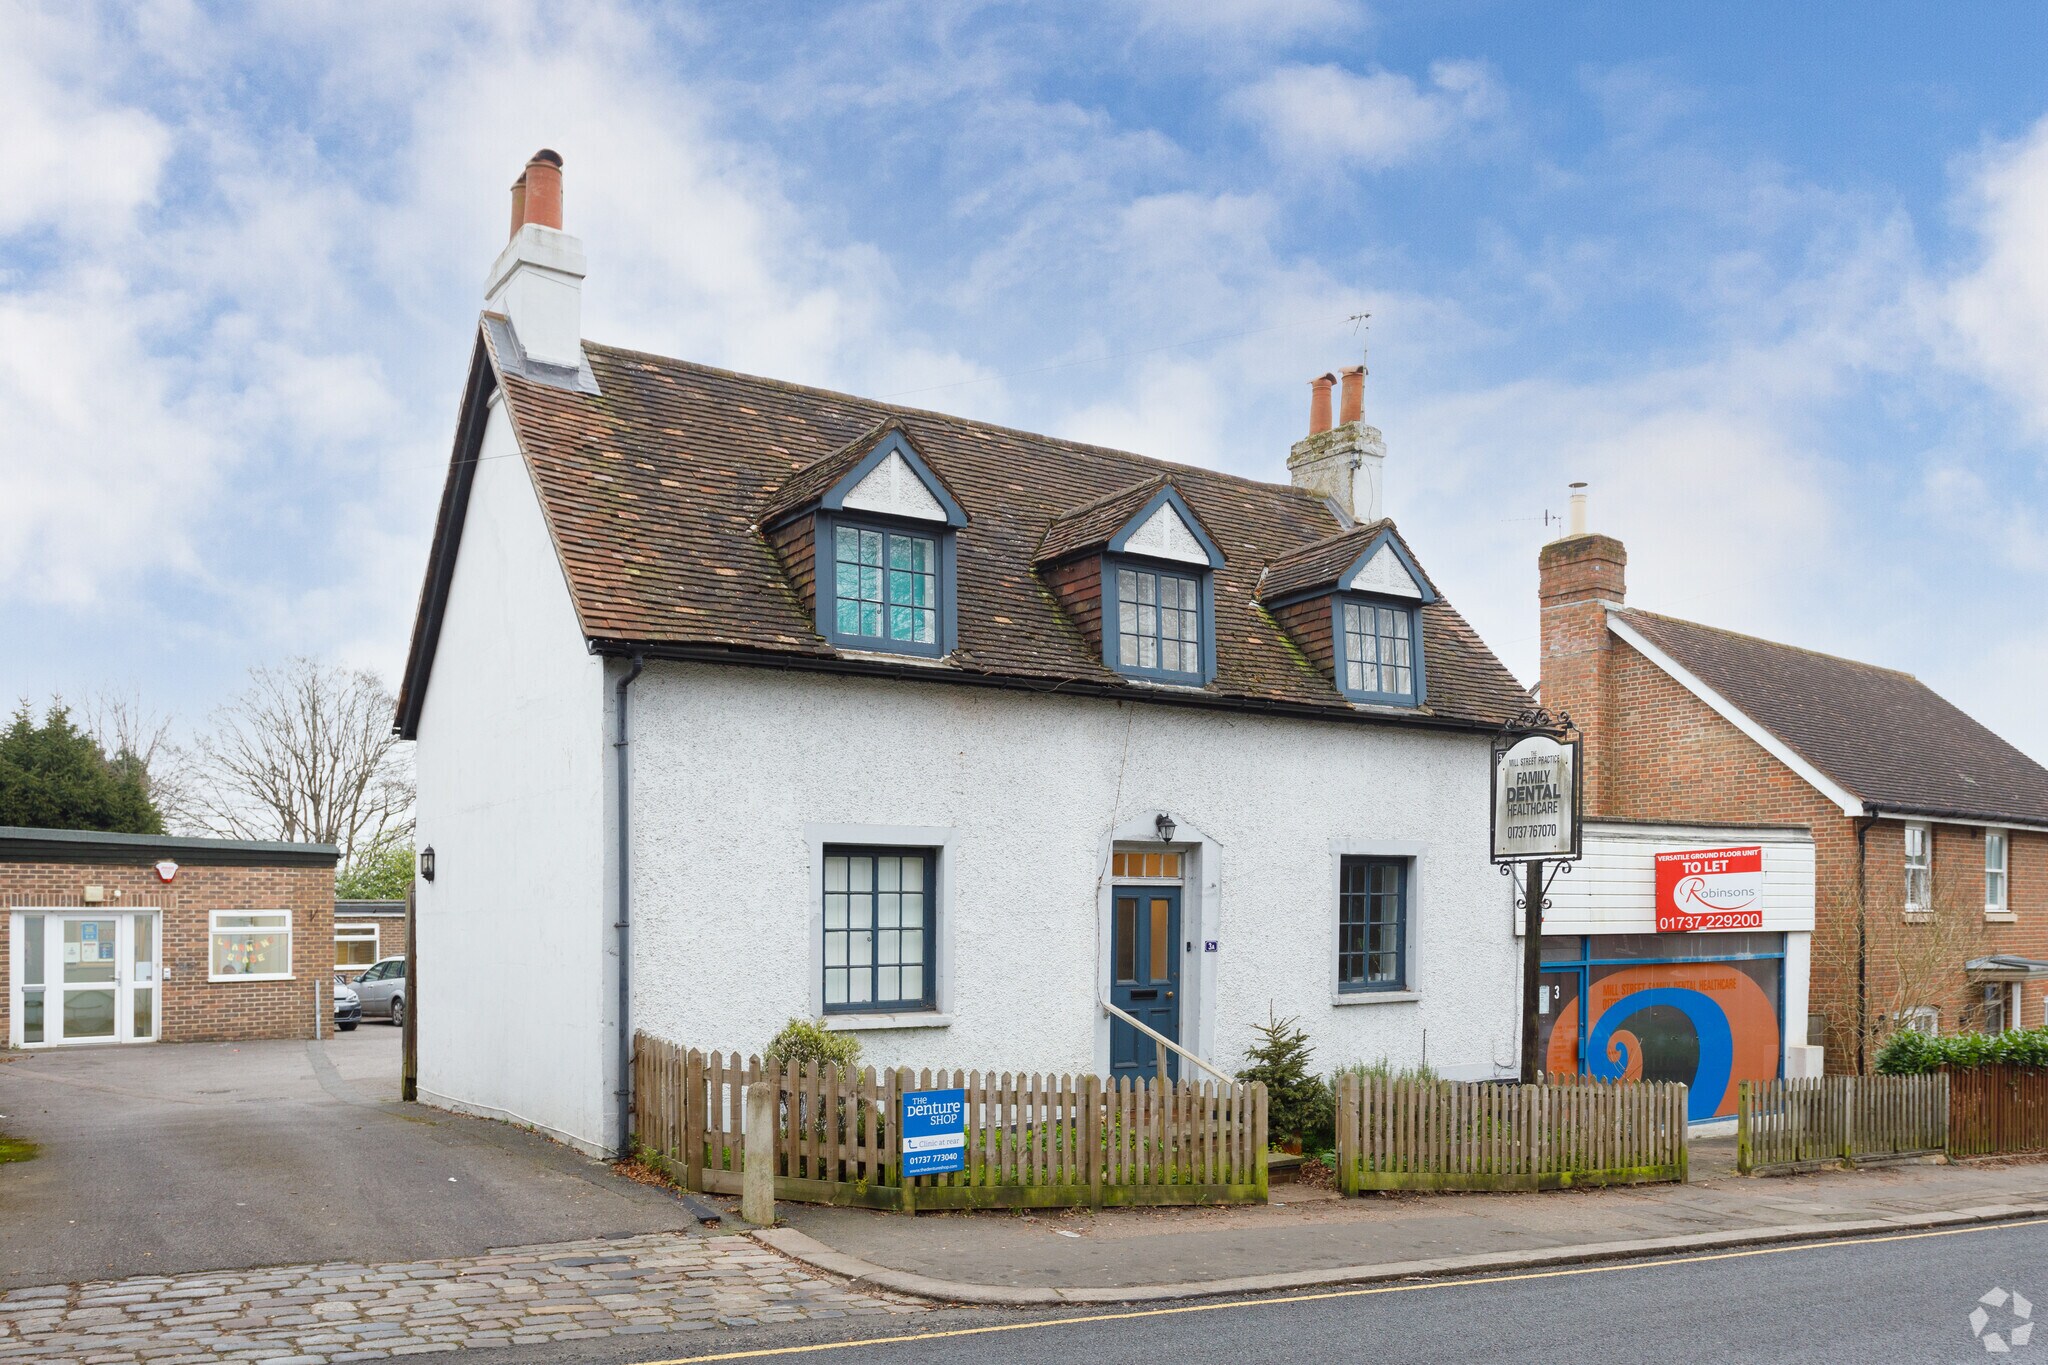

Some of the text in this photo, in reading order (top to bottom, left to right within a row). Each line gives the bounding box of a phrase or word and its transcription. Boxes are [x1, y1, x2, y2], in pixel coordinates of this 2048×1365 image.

[1520, 756, 1537, 766] STREET
[1538, 754, 1560, 765] PRACTICE
[1516, 770, 1550, 785] FAMILY
[1506, 784, 1561, 802] DENTAL
[1507, 801, 1558, 817] HEALTHCARE
[1657, 854, 1690, 862] VERSATILE
[1690, 851, 1719, 859] GROUND
[1720, 850, 1741, 858] FLOOR
[1683, 860, 1729, 873] TO LET
[1680, 877, 1756, 909] Robinsons
[1660, 913, 1760, 930] 01737 229200
[1554, 985, 1560, 1000] 3
[1602, 984, 1618, 996] MILL
[1699, 978, 1736, 990] HEALTHCARE
[930, 1114, 957, 1126] SHOP
[919, 1140, 937, 1148] Clinic
[910, 1153, 957, 1165] 01737 773040
[910, 1164, 957, 1173] www.thedentureshop.com
